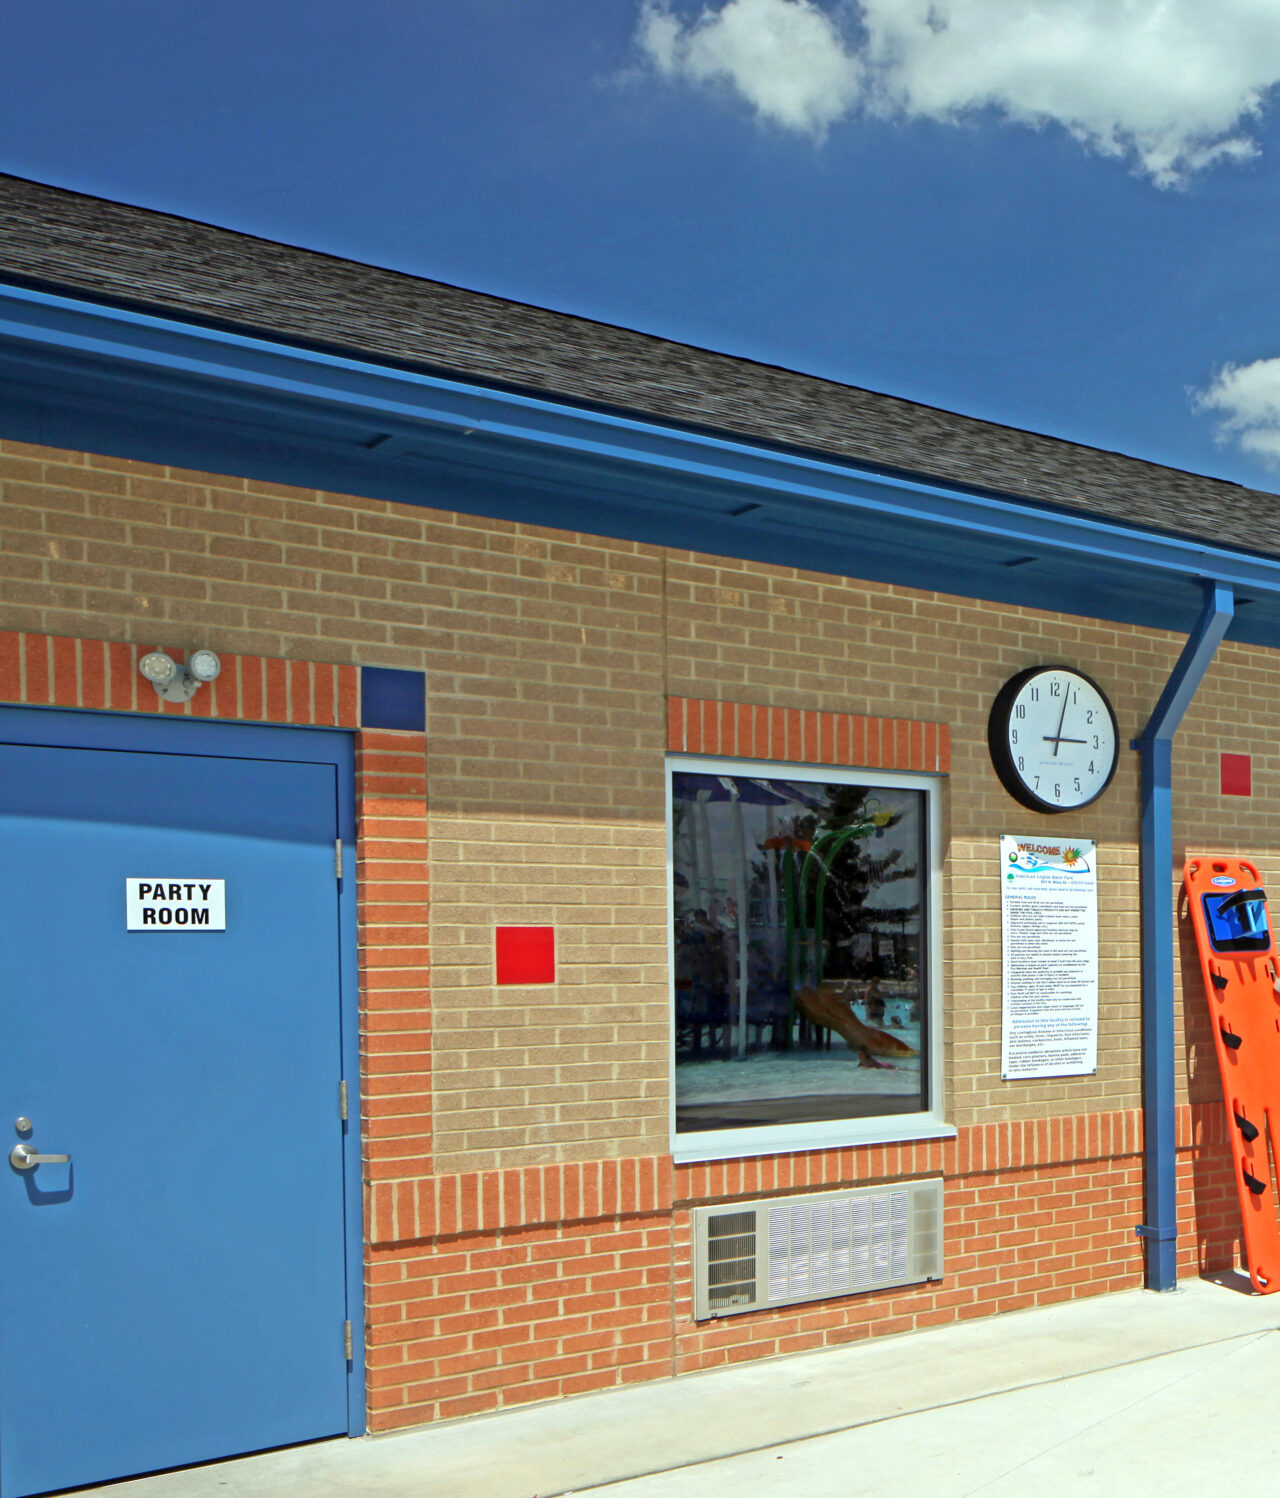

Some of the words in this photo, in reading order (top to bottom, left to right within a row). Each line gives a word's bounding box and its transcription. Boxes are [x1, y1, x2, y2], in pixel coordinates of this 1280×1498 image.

[1031, 687, 1039, 702] 11
[1050, 682, 1060, 697] 12
[1015, 704, 1025, 719] 10
[1086, 710, 1093, 725] 2
[1012, 729, 1018, 744] 9
[1093, 735, 1099, 750] 3
[1018, 756, 1024, 771] 8
[1088, 760, 1094, 775] 4
[1034, 776, 1040, 790] 7
[1054, 783, 1061, 798] 6
[1073, 777, 1080, 792] 5
[1017, 843, 1062, 856] WELCOME
[139, 883, 212, 901] PARTY
[143, 907, 209, 925] ROOM
